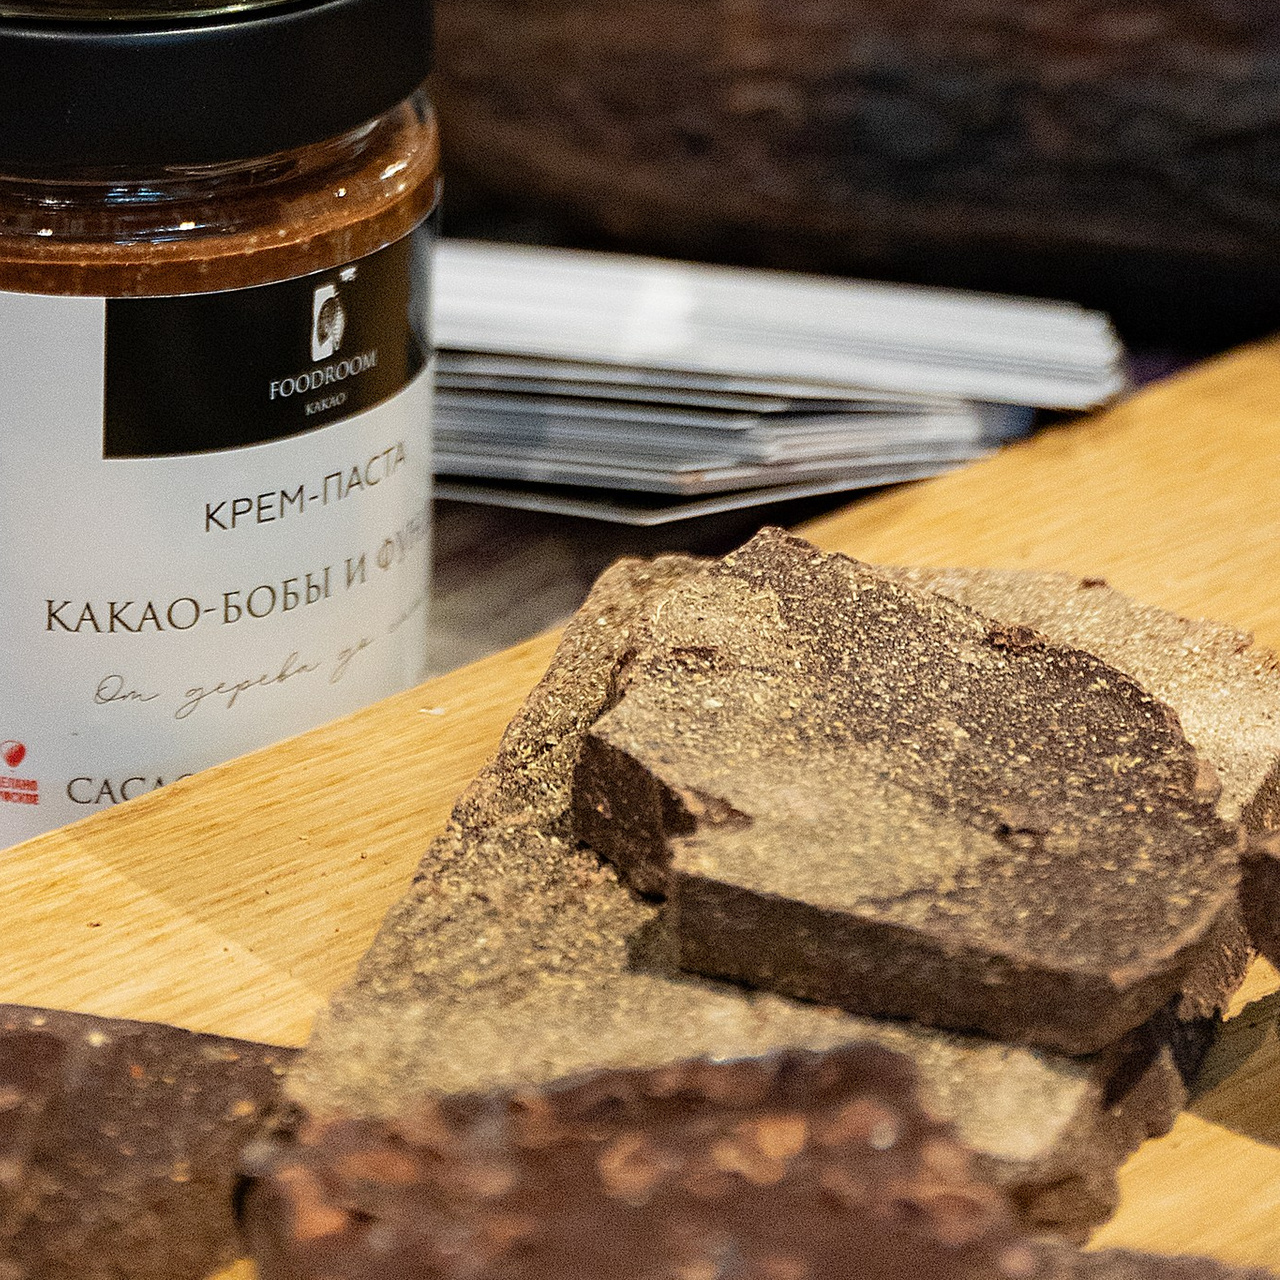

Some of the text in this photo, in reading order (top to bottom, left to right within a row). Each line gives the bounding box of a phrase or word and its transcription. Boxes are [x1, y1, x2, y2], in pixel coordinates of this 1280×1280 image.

[269, 350, 379, 401] FOODROOM
[204, 440, 408, 534] КРЕМ-ПАСТА
[44, 566, 332, 635] КАКАО-БОБЫ
[343, 552, 367, 590] И
[66, 772, 194, 806] CAC
